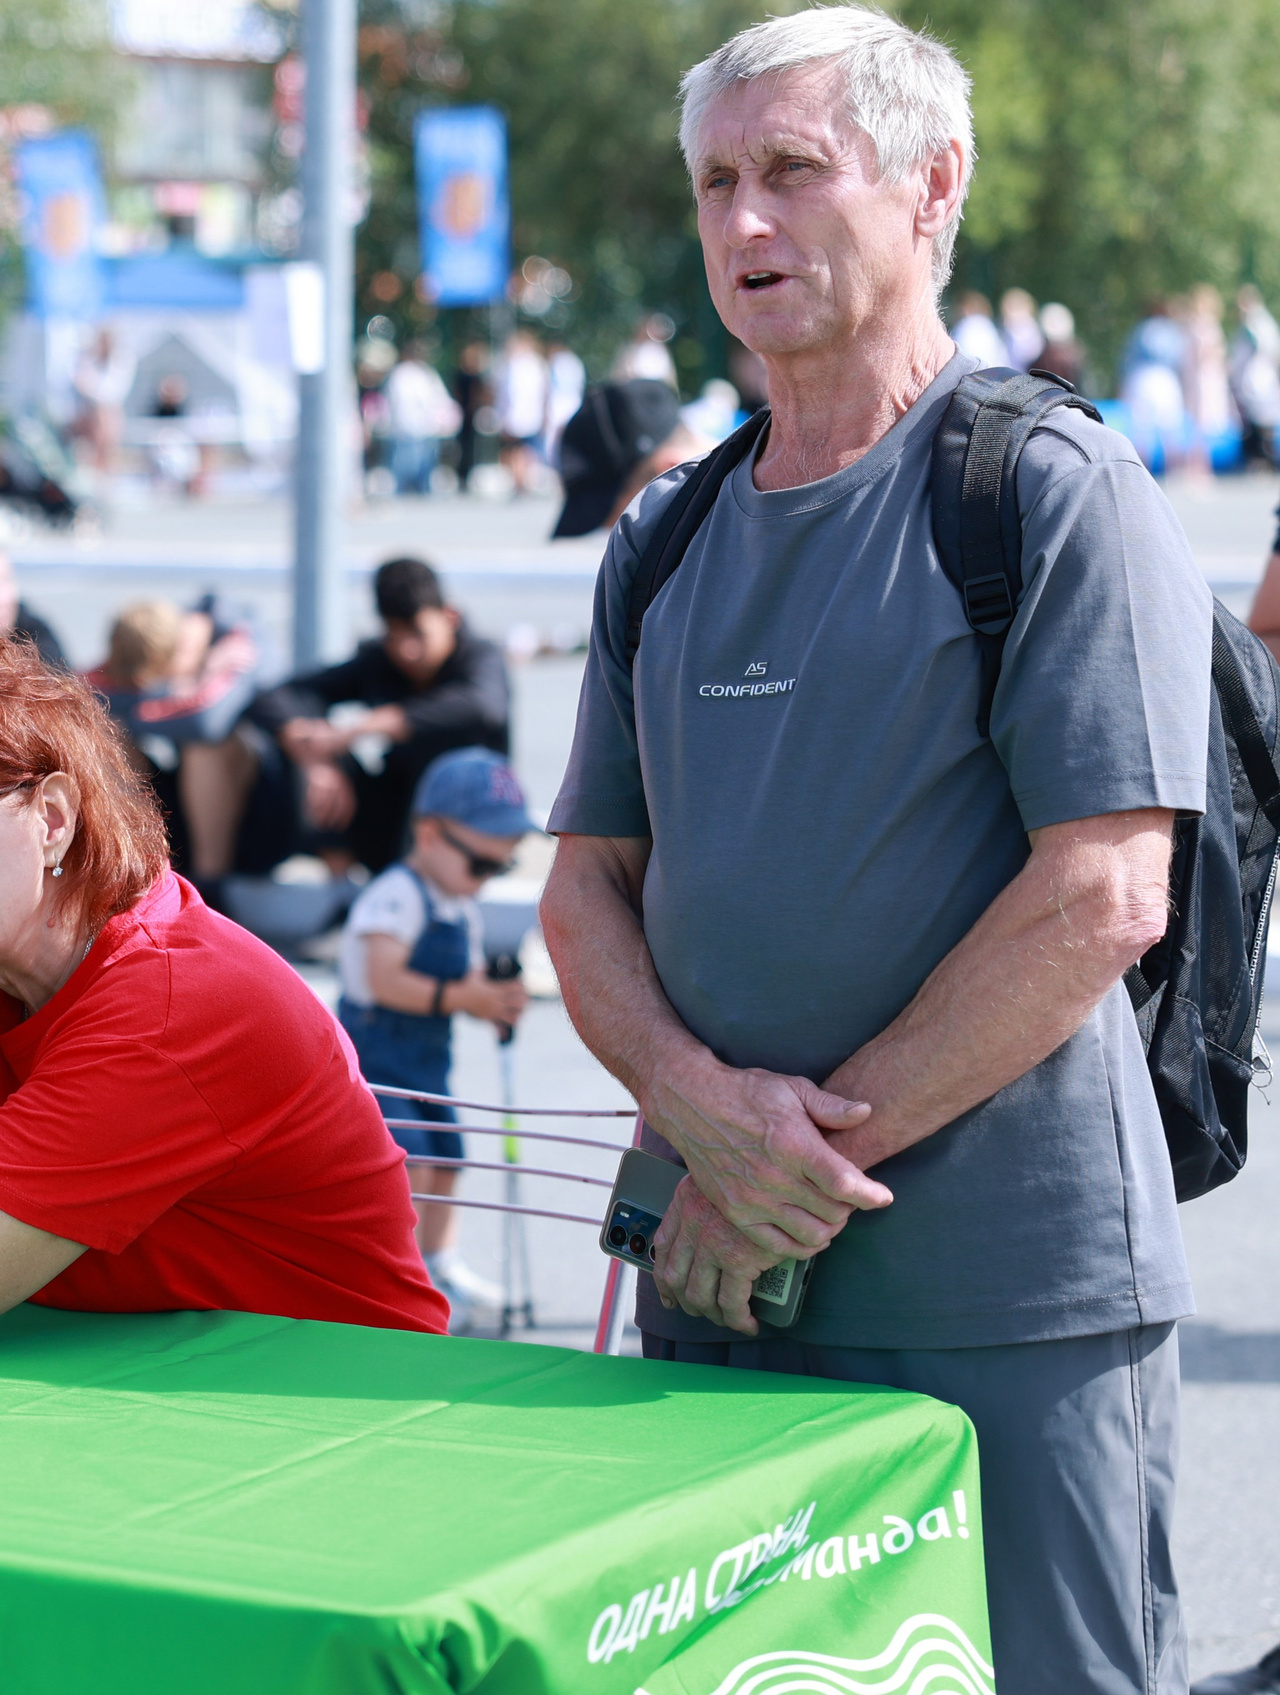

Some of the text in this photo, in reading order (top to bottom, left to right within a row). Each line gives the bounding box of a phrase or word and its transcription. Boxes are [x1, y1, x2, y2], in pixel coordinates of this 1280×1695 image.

[744, 661, 768, 676] AS
[699, 678, 796, 697] CONFIDENT
[587, 1566, 697, 1664] ОДНА
